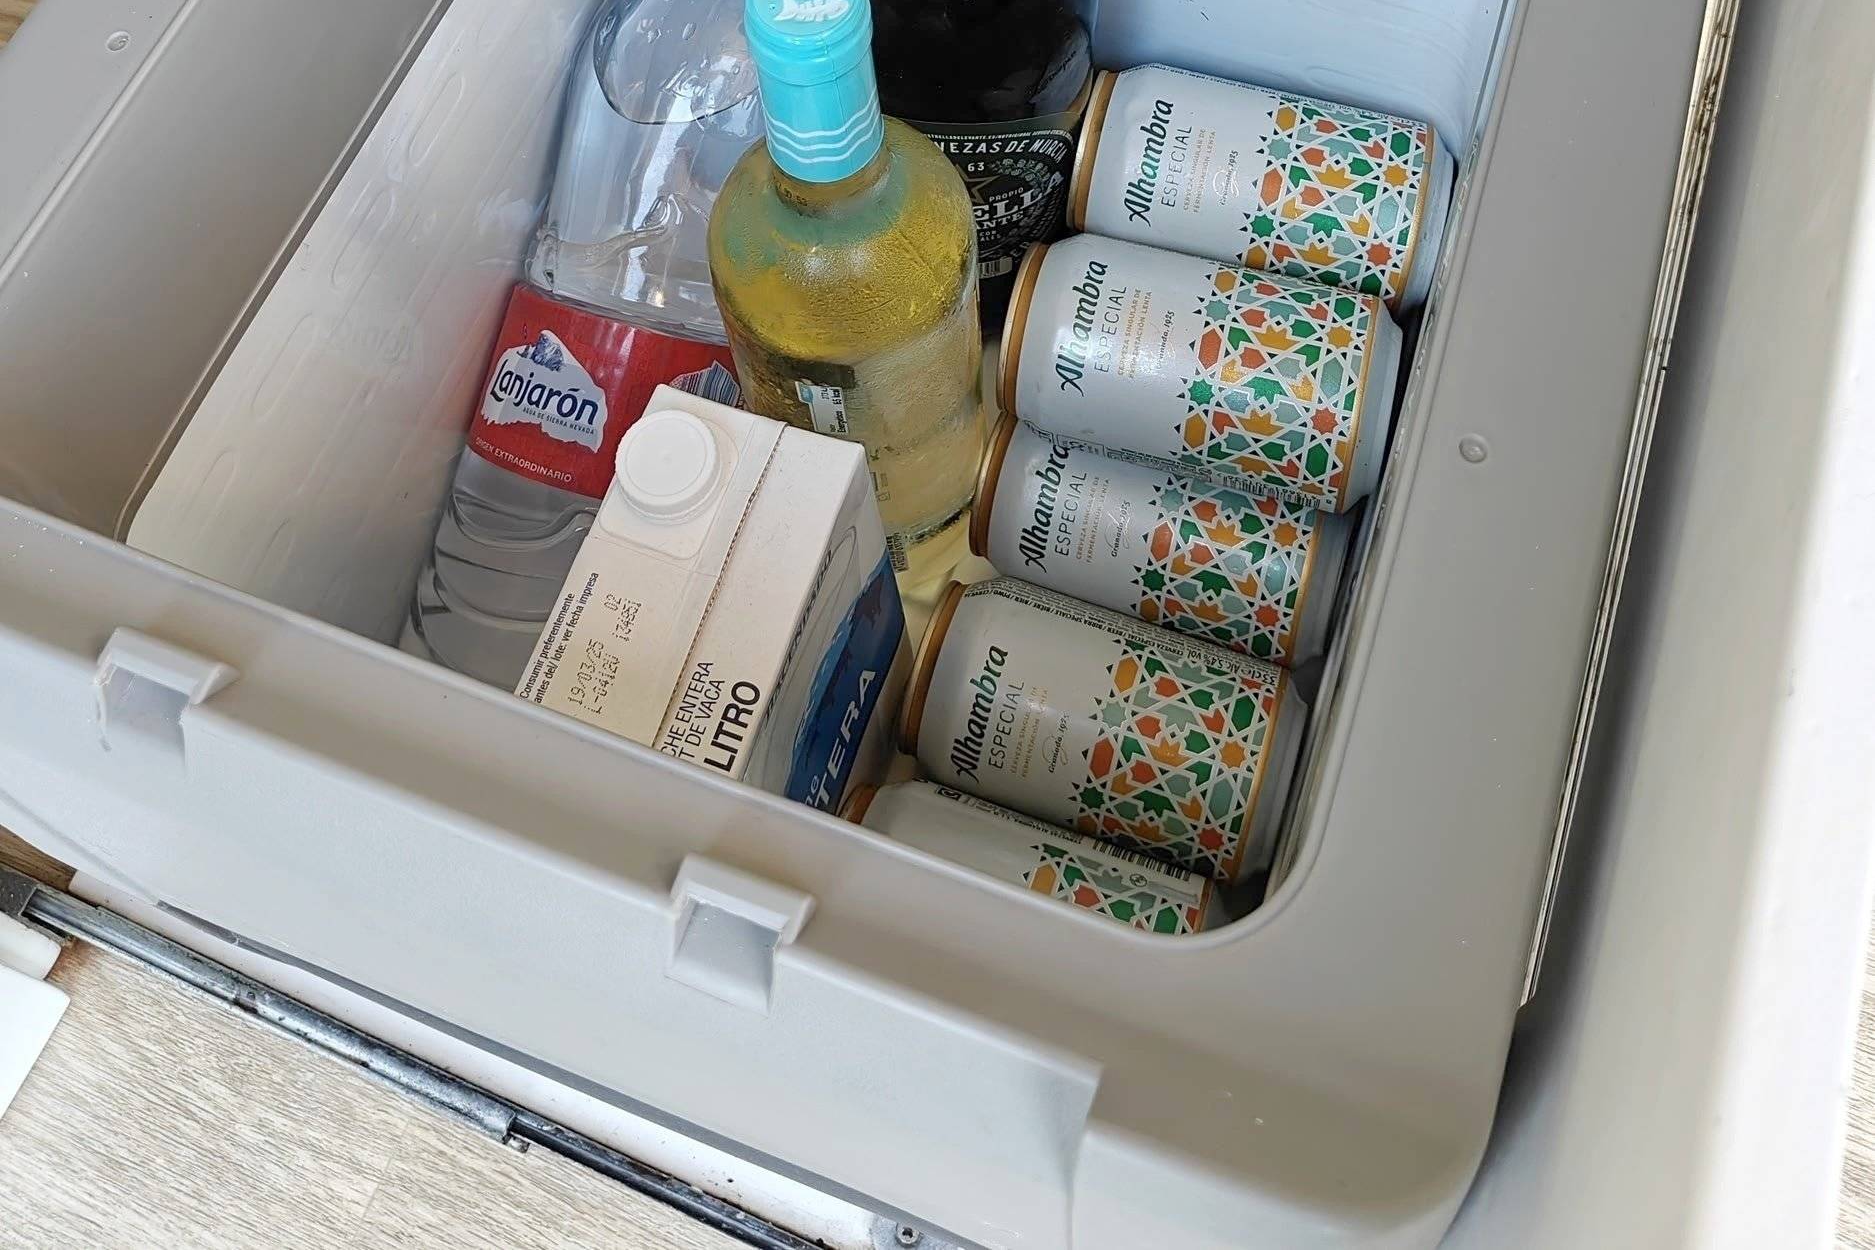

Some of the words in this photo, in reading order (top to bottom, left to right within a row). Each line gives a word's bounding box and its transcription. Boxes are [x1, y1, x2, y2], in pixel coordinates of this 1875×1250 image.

[967, 161, 985, 172] 63
[1004, 139, 1030, 153] DE
[1028, 139, 1068, 164] MURCIA
[1123, 98, 1175, 228] Alhambra
[1160, 125, 1193, 209] ESPECIAL
[989, 187, 1024, 202] PROPIO
[1124, 299, 1138, 337] SINGULAR
[1142, 291, 1152, 314] LENTA
[1163, 310, 1175, 328] 1925
[1055, 259, 1109, 398] Alhambra
[1095, 285, 1128, 373] ESPECIAL
[490, 358, 599, 426] Lanjarón
[546, 415, 567, 427] SIERRA
[495, 448, 572, 482] EXTRAORDINARIO
[1018, 444, 1070, 574] Alhambra
[1053, 471, 1087, 557] ESPECIAL
[577, 571, 600, 606] impresa
[562, 629, 573, 642] ver
[566, 604, 584, 628] fecha
[519, 659, 545, 700] Consumir
[539, 592, 576, 660] preferentemente
[551, 642, 567, 662] lote:
[533, 679, 550, 703] antes
[567, 638, 605, 706] 19/03/25
[675, 658, 713, 724] ENTERA
[695, 676, 725, 722] VACA
[950, 644, 1008, 784] Alhambra
[685, 722, 706, 746] DE
[703, 677, 763, 772] LITRO
[988, 680, 1025, 769] ESPECIAL
